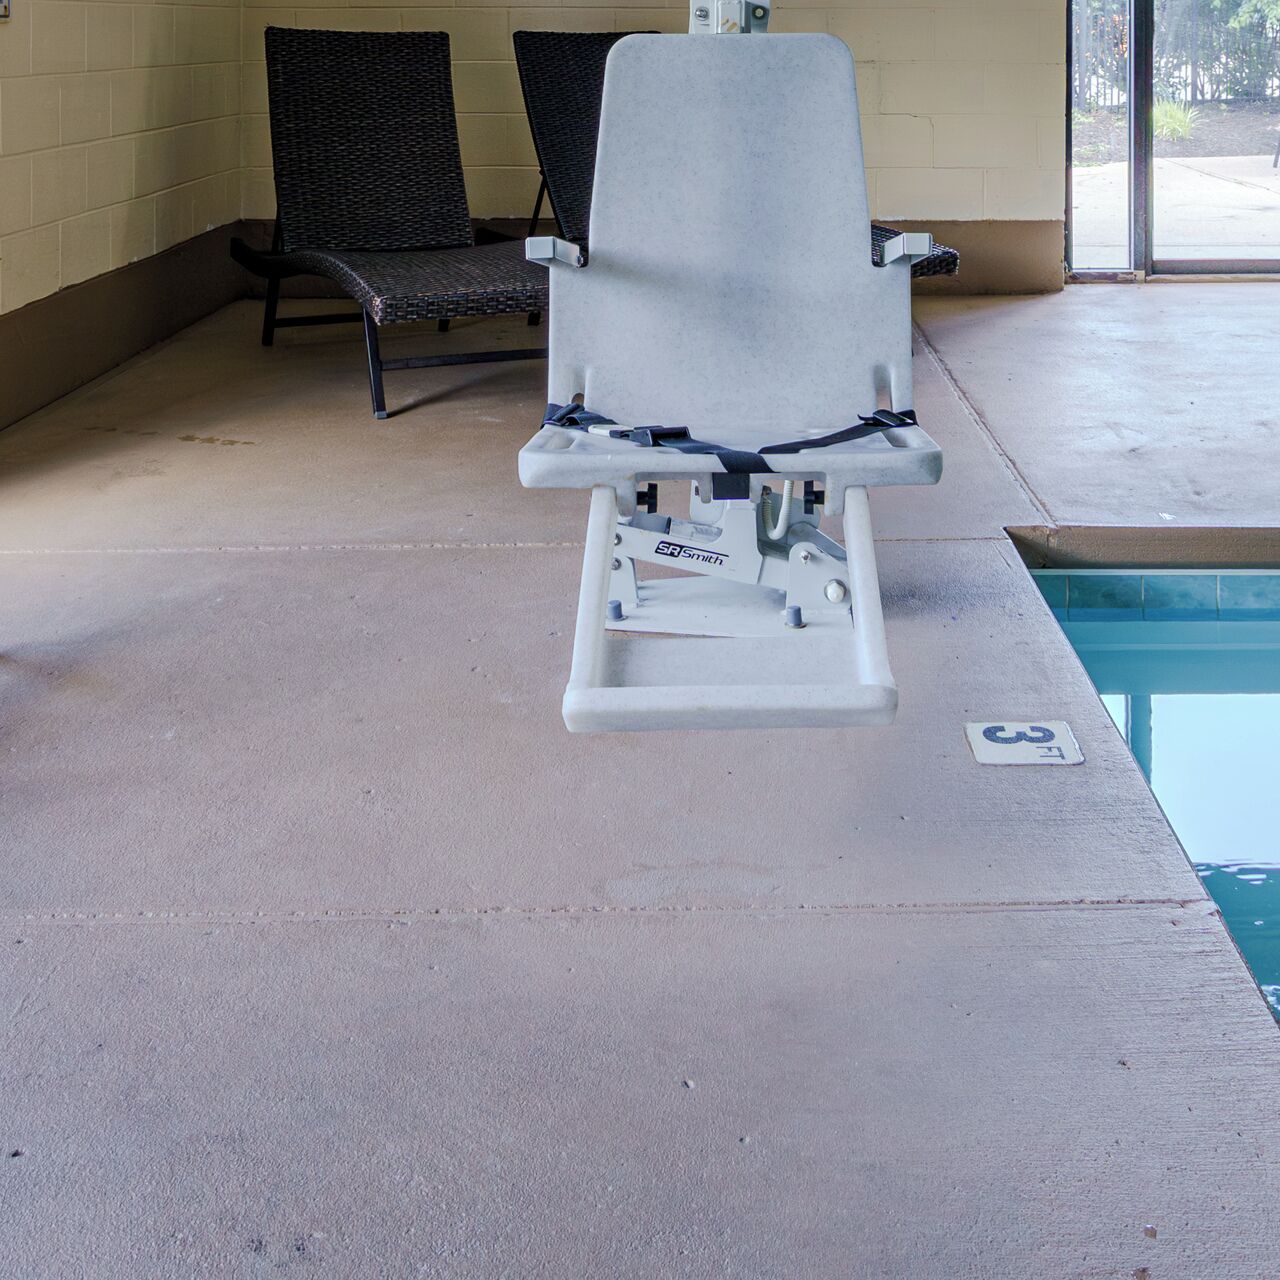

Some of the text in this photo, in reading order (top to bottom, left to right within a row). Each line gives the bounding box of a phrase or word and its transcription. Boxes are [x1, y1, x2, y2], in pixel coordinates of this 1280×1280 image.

[657, 544, 724, 566] SR Smith
[982, 725, 1056, 744] 3
[1036, 746, 1066, 760] FT
